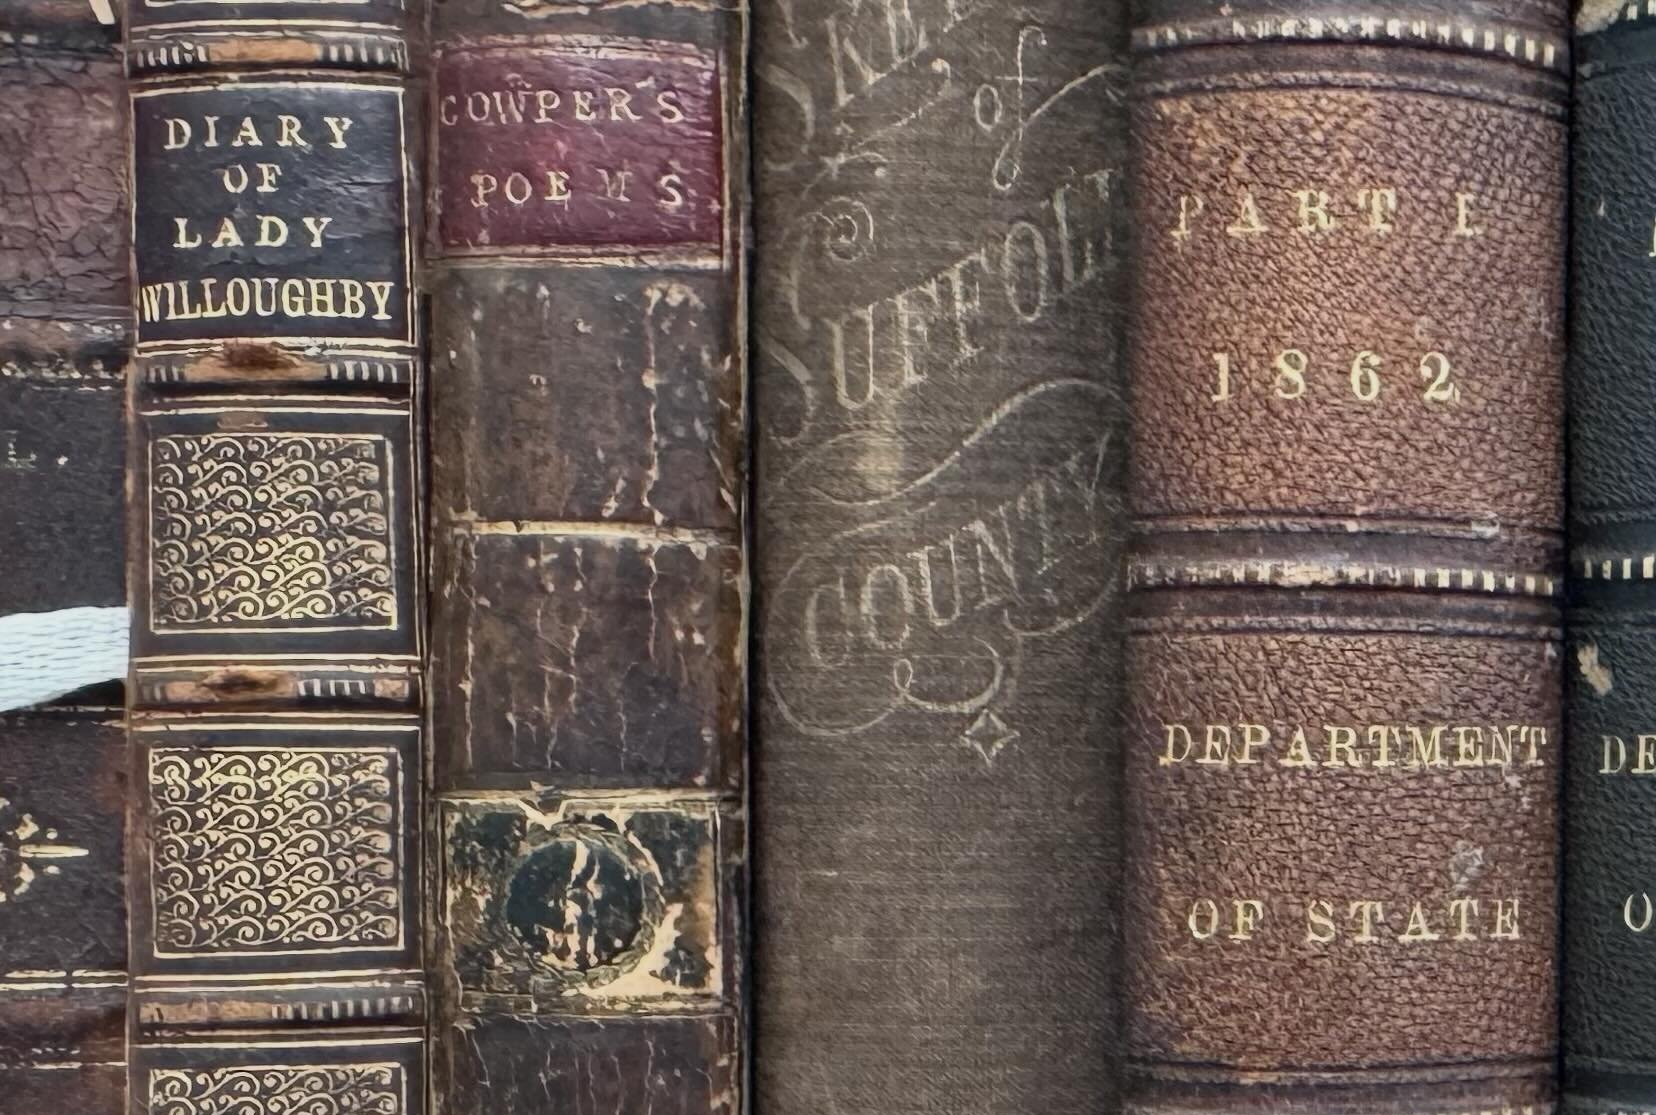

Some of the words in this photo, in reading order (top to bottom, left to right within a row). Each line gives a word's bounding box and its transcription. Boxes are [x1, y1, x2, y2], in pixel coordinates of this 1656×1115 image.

[973, 24, 1048, 191] of
[162, 113, 354, 151] DIARY
[222, 162, 283, 194] OF
[469, 167, 685, 208] POEMS
[172, 214, 333, 249] LADY
[1169, 188, 1398, 238] PART
[140, 276, 396, 323] WILLOUGHBY
[1158, 721, 1548, 771] DEPARTMENT
[1187, 896, 1266, 944] OF
[1303, 896, 1521, 944] STATE
